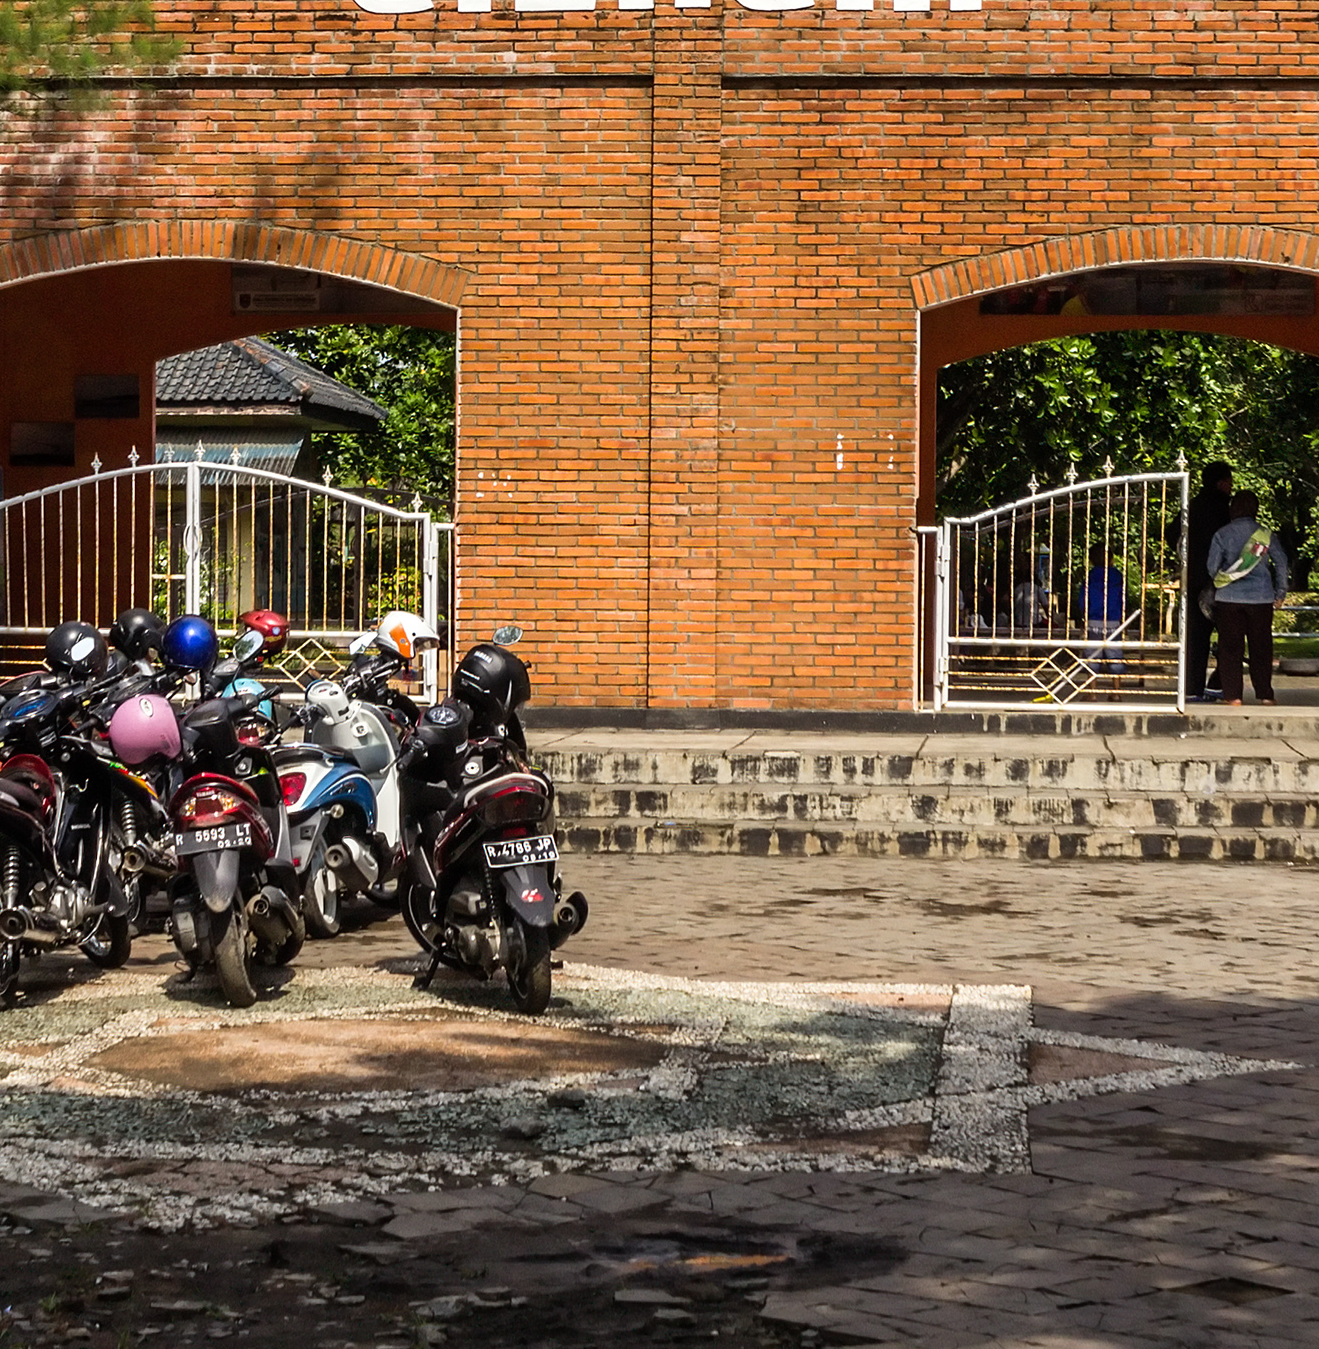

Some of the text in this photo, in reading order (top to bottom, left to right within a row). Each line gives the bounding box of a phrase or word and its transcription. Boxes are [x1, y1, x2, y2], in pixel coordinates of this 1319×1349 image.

[175, 833, 184, 847] R
[235, 822, 252, 837] LT
[486, 845, 497, 858] R
[535, 837, 552, 852] JP
